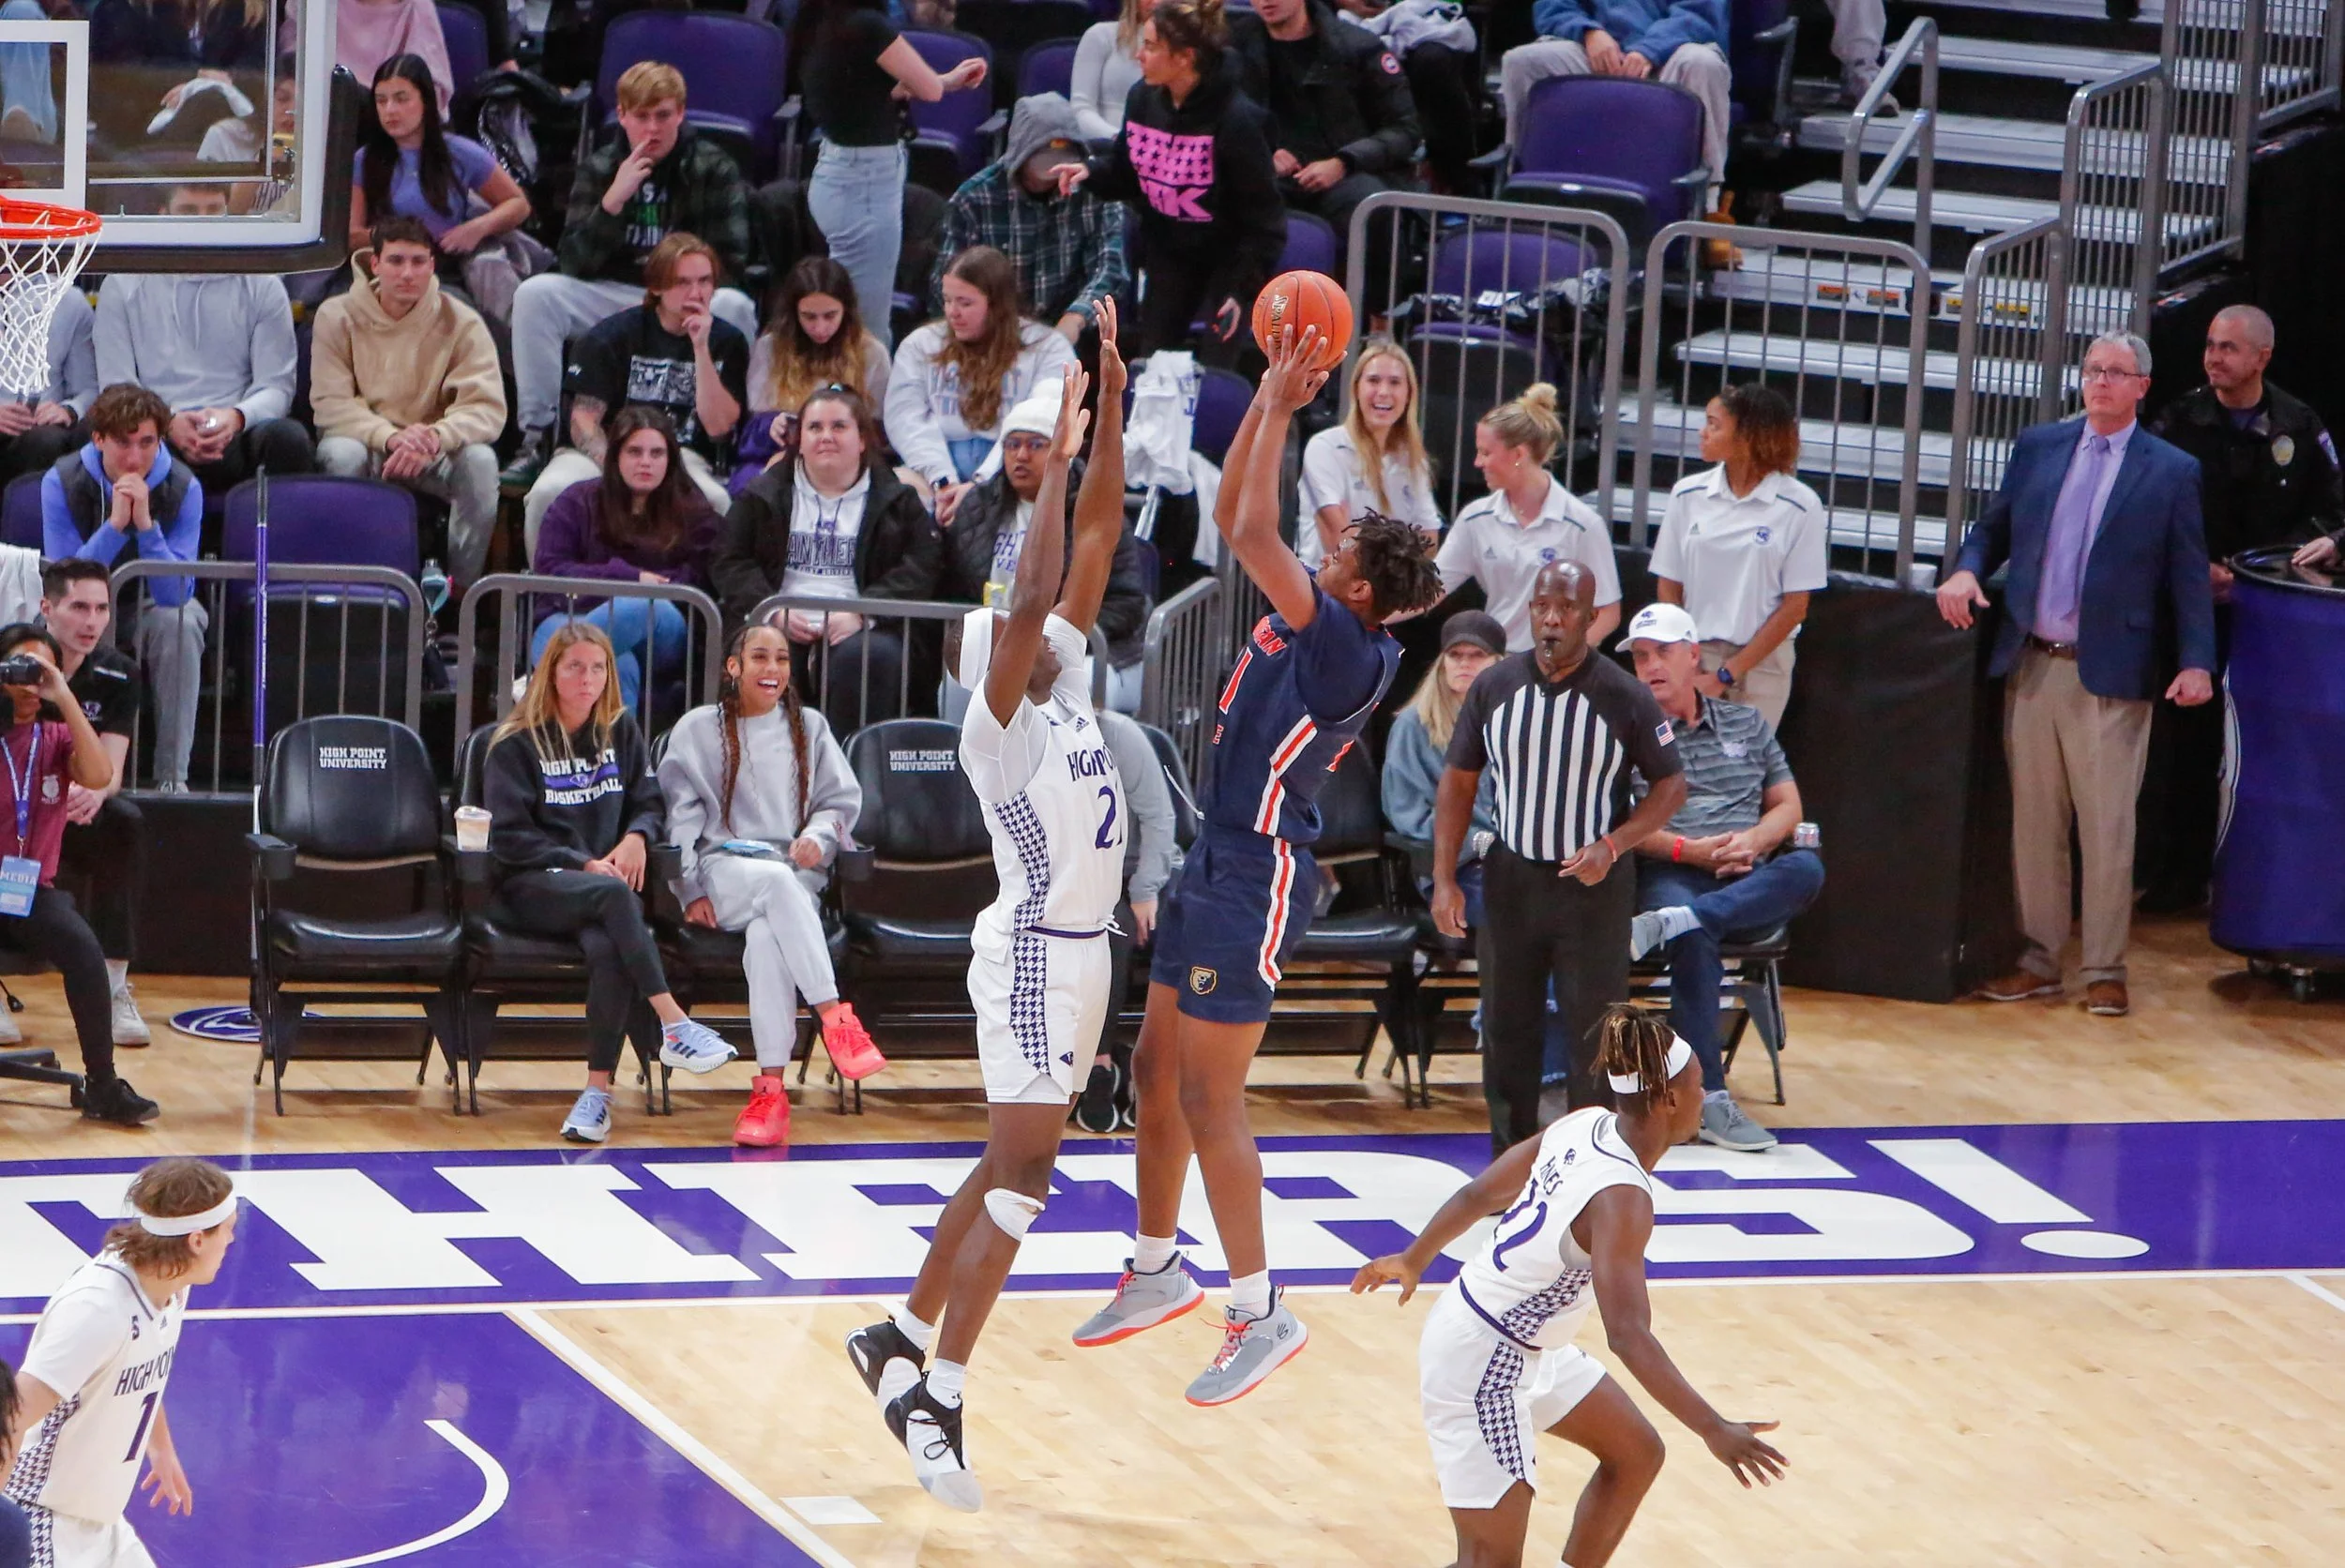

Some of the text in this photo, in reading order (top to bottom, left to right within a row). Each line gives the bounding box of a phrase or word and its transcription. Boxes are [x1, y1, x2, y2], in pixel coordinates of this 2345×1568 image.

[319, 746, 386, 759] HIGH POINT
[889, 750, 954, 761] HIGH POINT
[319, 758, 387, 769] UNIVERSITY
[889, 761, 956, 771] UNIVERSITY
[122, 1391, 159, 1463] 1
